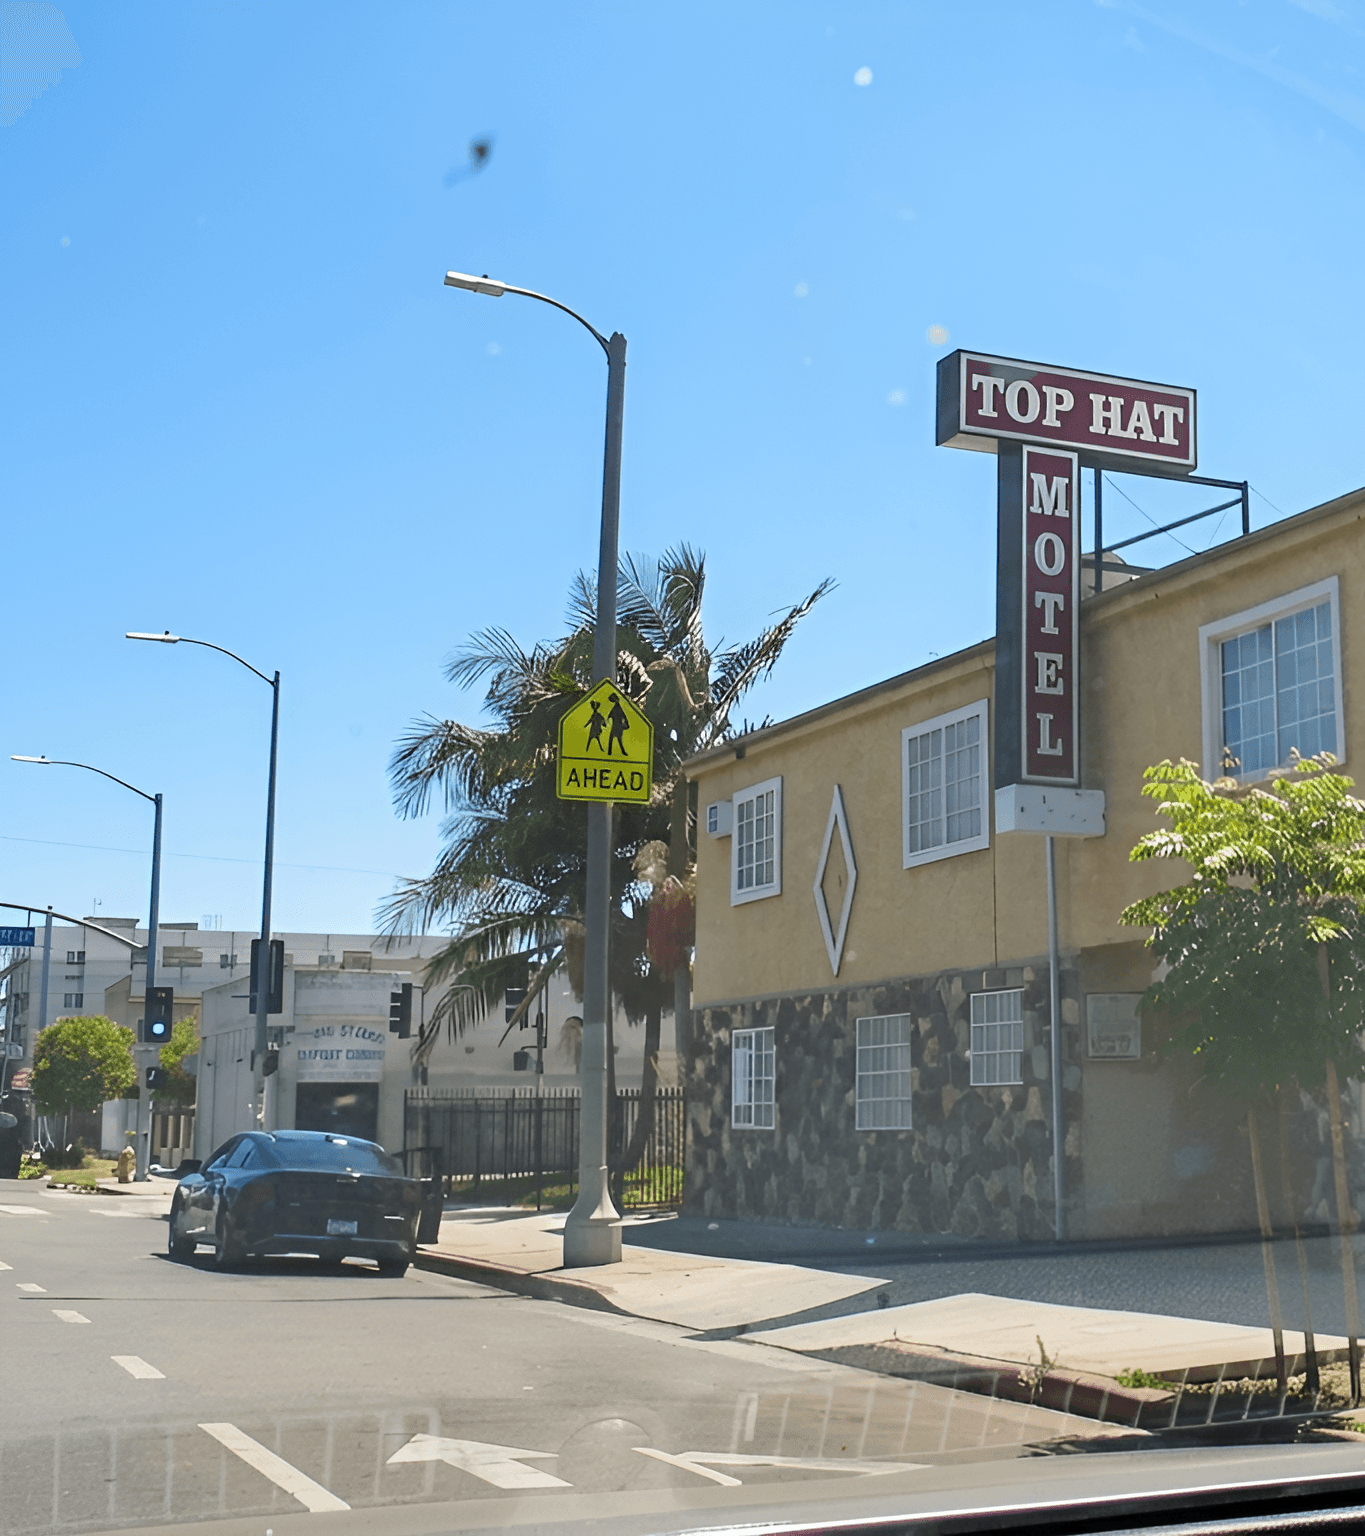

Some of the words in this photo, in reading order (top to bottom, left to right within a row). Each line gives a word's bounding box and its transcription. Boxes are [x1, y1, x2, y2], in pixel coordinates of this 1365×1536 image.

[971, 373, 1075, 427] TOP
[1089, 393, 1184, 446] HAT
[1029, 472, 1070, 757] MOTEL
[565, 768, 645, 791] AHEAD
